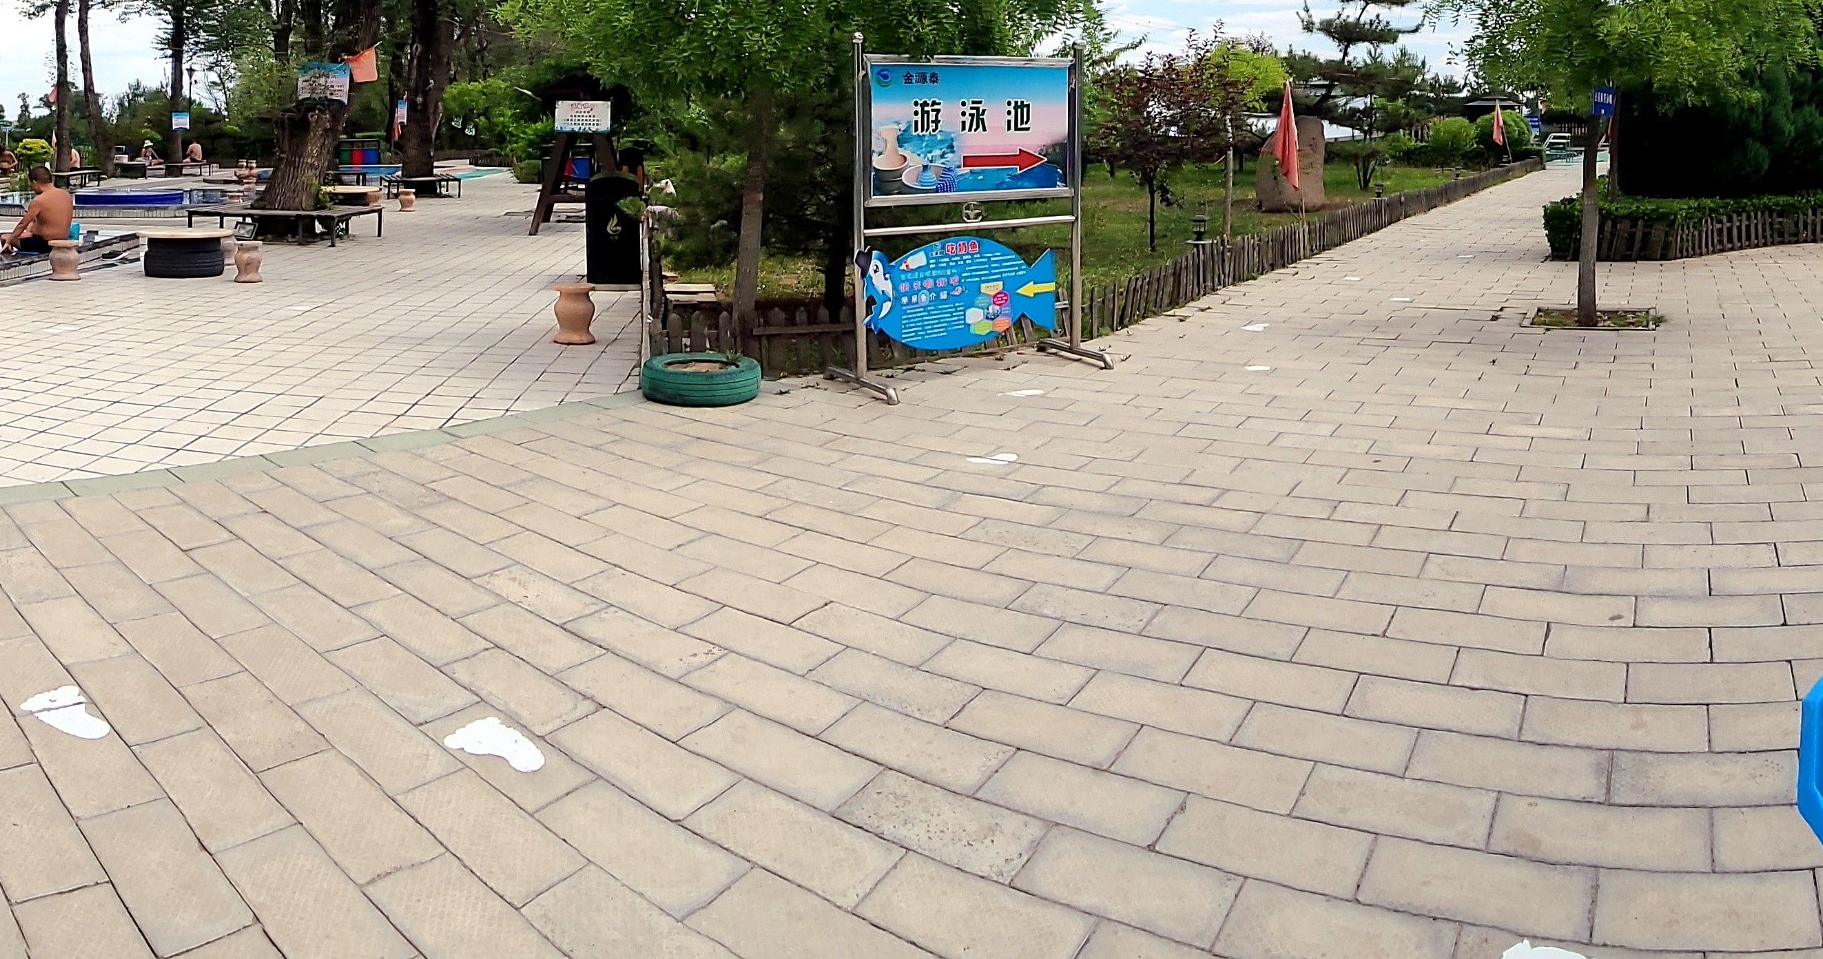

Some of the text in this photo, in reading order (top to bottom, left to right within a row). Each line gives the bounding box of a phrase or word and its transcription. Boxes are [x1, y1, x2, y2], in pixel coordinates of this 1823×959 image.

[903, 71, 941, 85] 金源泰
[912, 98, 1033, 135] 游泳池
